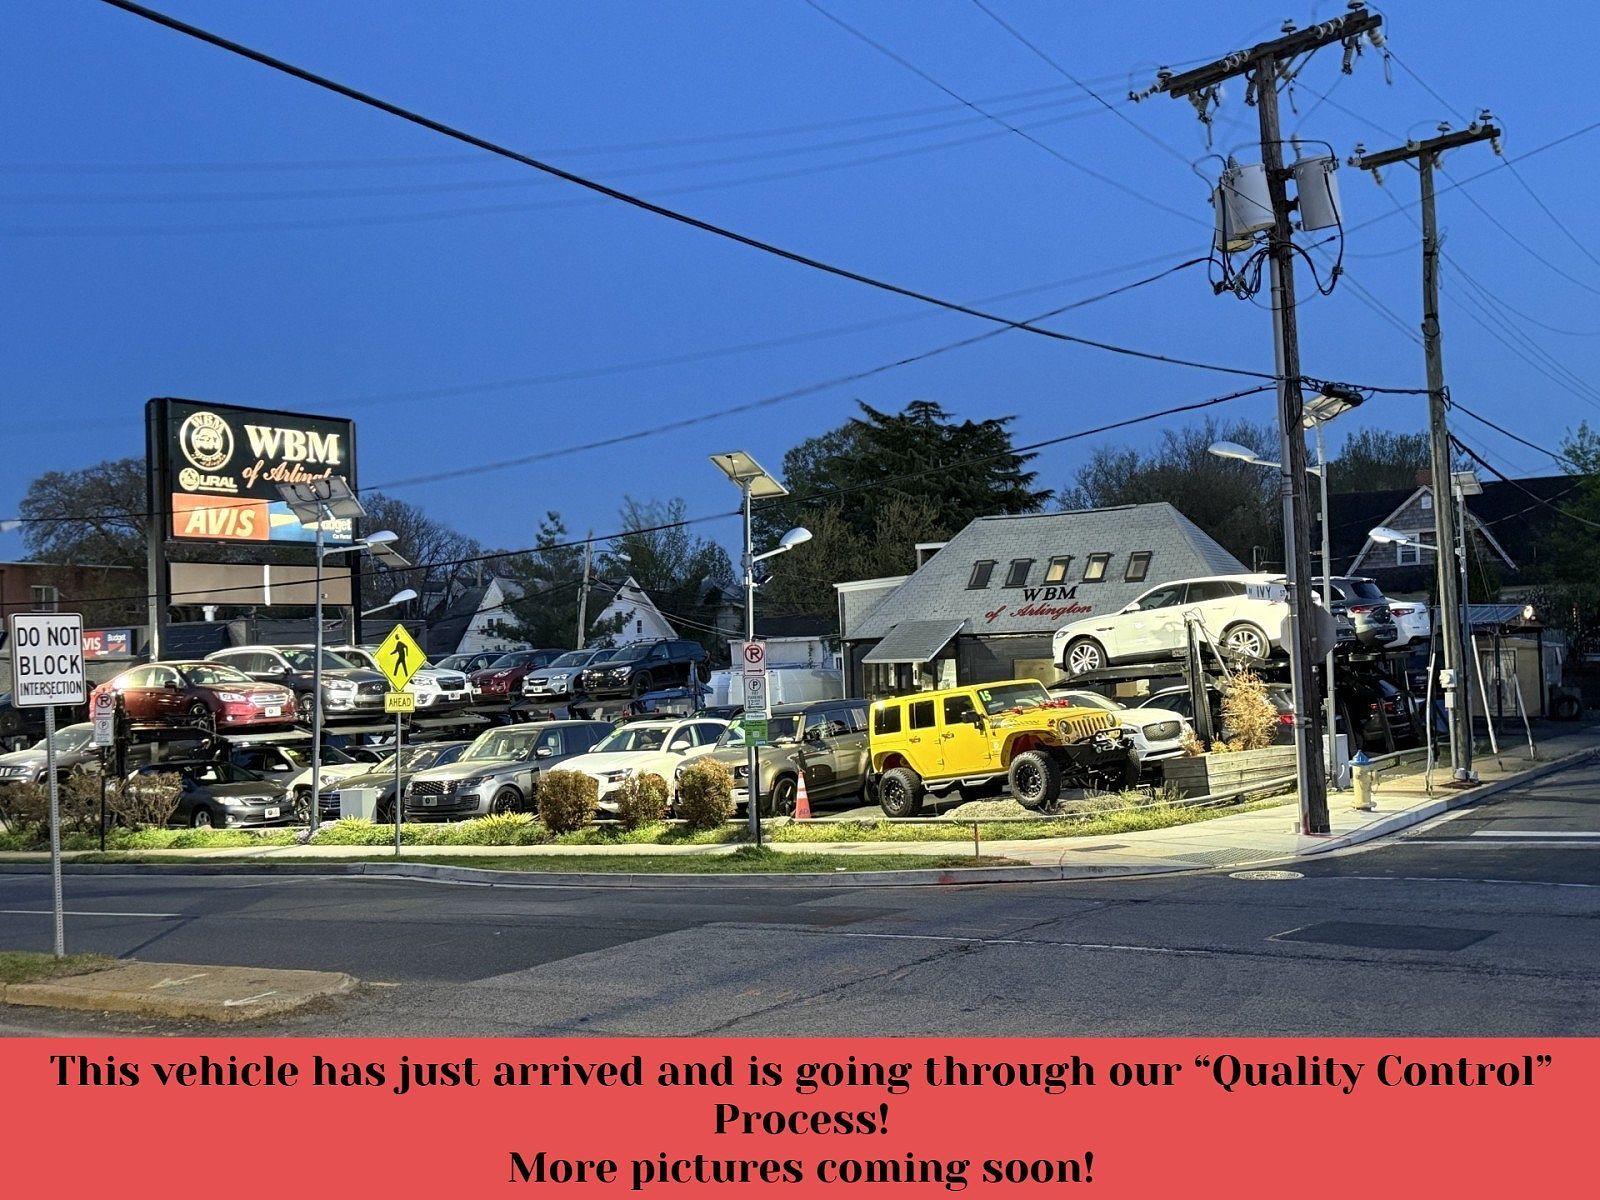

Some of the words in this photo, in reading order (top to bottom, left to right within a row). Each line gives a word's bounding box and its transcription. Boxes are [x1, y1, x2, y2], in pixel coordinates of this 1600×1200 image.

[243, 424, 341, 466] WBM
[242, 459, 264, 489] of
[184, 506, 257, 538] AVIS
[1023, 586, 1078, 602] WBM
[1256, 585, 1271, 599] IVY
[985, 605, 1007, 624] of
[1010, 601, 1092, 620] Arlington
[17, 627, 40, 647] DO
[47, 626, 79, 646] NOT
[107, 633, 127, 643] Budget
[20, 654, 81, 676] BLOCK
[20, 680, 82, 696] INTERSECTION
[388, 697, 412, 707] AHEAD
